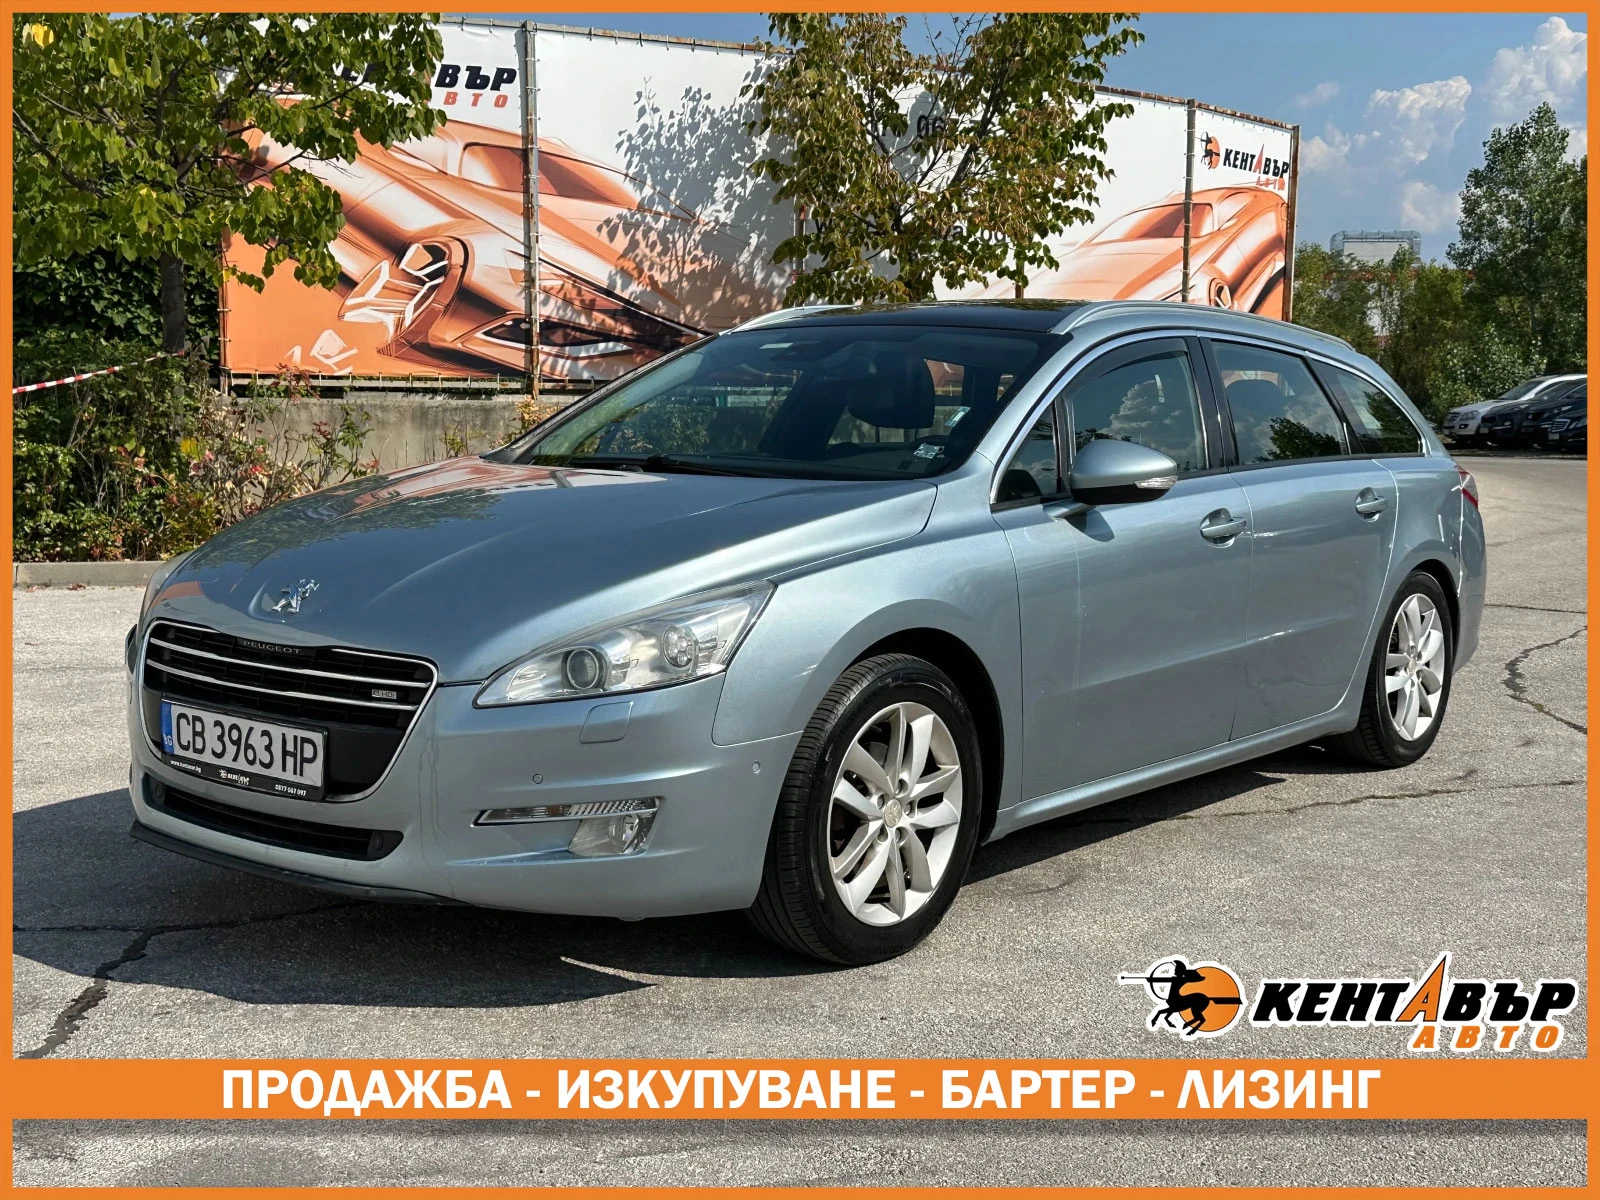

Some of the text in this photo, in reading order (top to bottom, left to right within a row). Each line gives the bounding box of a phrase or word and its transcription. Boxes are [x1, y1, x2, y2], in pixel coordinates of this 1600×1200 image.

[1223, 143, 1290, 178] КЕНТАВЪР
[242, 640, 301, 655] PEUGEOT
[211, 719, 274, 770] 3963
